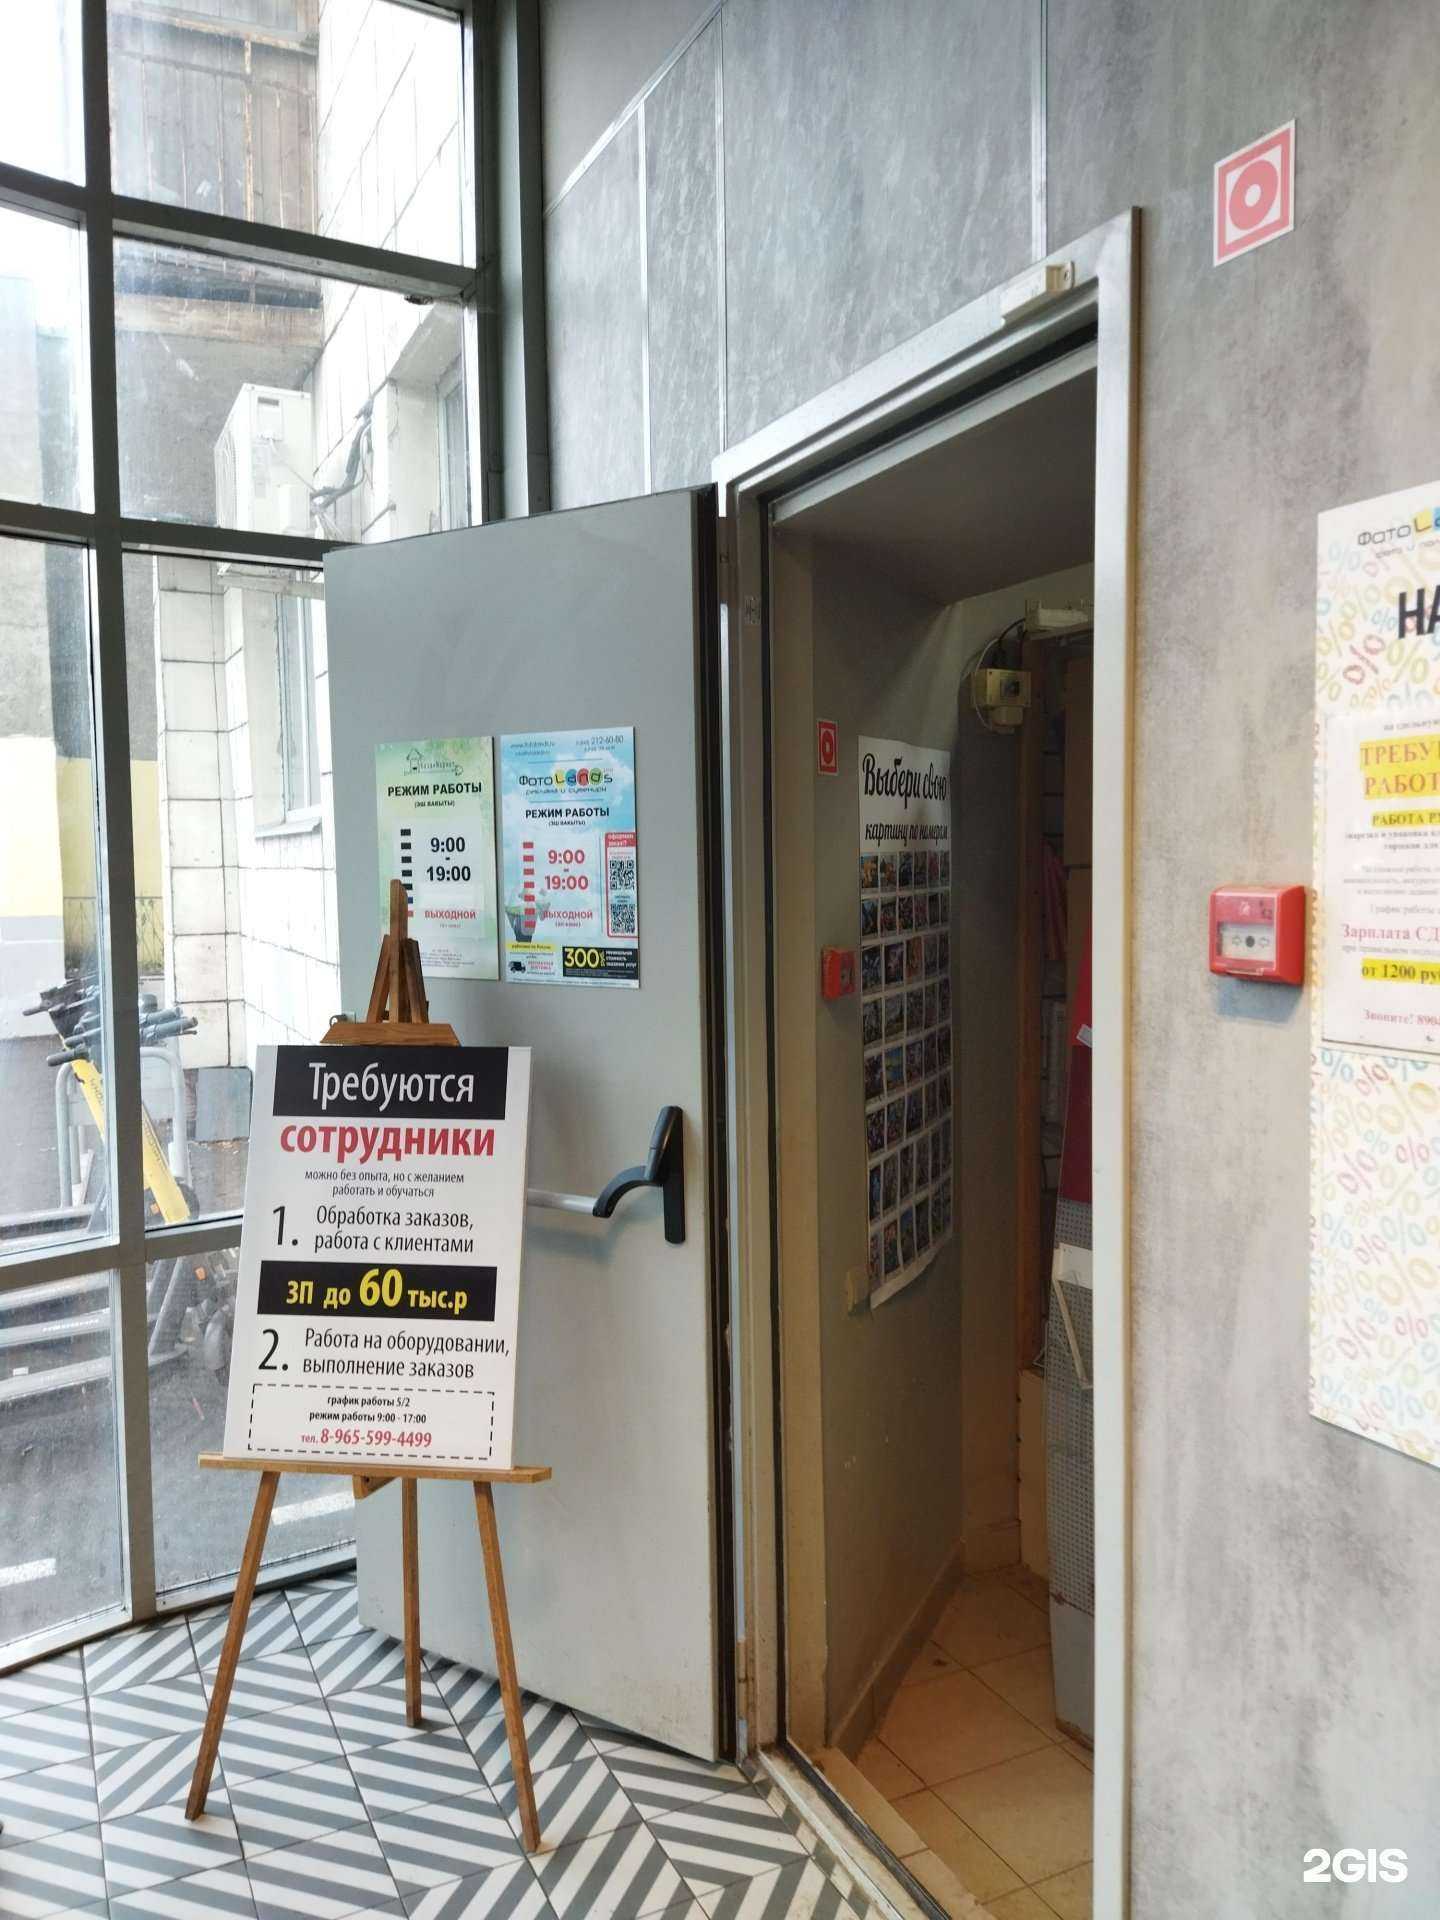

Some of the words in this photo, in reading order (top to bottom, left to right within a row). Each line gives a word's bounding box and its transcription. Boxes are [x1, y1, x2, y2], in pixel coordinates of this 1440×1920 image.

[1360, 740, 1440, 767] ТРЕБУ
[388, 785, 430, 797] РЕЖИМ
[432, 781, 482, 796] РАБОТЫ
[862, 753, 920, 809] Выбери
[922, 761, 947, 800] свою
[525, 807, 563, 819] РЕЖИМ
[565, 806, 610, 818] РАБОТЫ
[1372, 813, 1424, 826] РАБОТА
[864, 821, 908, 848] картину
[909, 823, 919, 840] по
[430, 837, 466, 852] 9:00
[548, 849, 585, 864] 9:00
[426, 865, 471, 881] 19:00
[544, 875, 589, 890] 19:00
[1342, 923, 1411, 942] Зарплата
[564, 948, 599, 968] 300
[1362, 966, 1376, 978] от
[1381, 963, 1416, 979] 1200
[309, 1062, 474, 1111] Требуются
[280, 1124, 495, 1165] сотрудники
[305, 1169, 338, 1181] можно
[340, 1168, 356, 1181] без
[359, 1170, 391, 1183] опыта,
[393, 1172, 405, 1182] но
[407, 1173, 413, 1182] с
[414, 1172, 464, 1183] желанием
[332, 1185, 376, 1198] работать
[377, 1187, 384, 1197] и
[385, 1187, 434, 1199] обучаться
[272, 1206, 299, 1246] 1.
[316, 1205, 400, 1228] Обработка
[405, 1213, 474, 1230] заказов,
[315, 1230, 369, 1253] работа
[373, 1237, 381, 1250] с
[385, 1236, 474, 1253] клиентами
[286, 1280, 314, 1304] ЗП
[323, 1287, 351, 1309] до
[359, 1268, 403, 1307] 60
[407, 1290, 468, 1315] тыс.р
[258, 1328, 289, 1371] 2.
[305, 1328, 359, 1349] Работа
[363, 1335, 382, 1350] на
[387, 1331, 510, 1357] оборудовании,
[302, 1358, 405, 1377] выполнение
[409, 1361, 474, 1379] заказов
[327, 1395, 359, 1408] график
[360, 1395, 395, 1408] работы
[396, 1396, 410, 1408] 5/2
[309, 1411, 340, 1423] режим
[341, 1411, 375, 1423] работы
[377, 1412, 396, 1423] 9:00
[403, 1413, 427, 1424] 17:00
[301, 1433, 319, 1445] тел.
[320, 1428, 432, 1447] 8-965-599-4499
